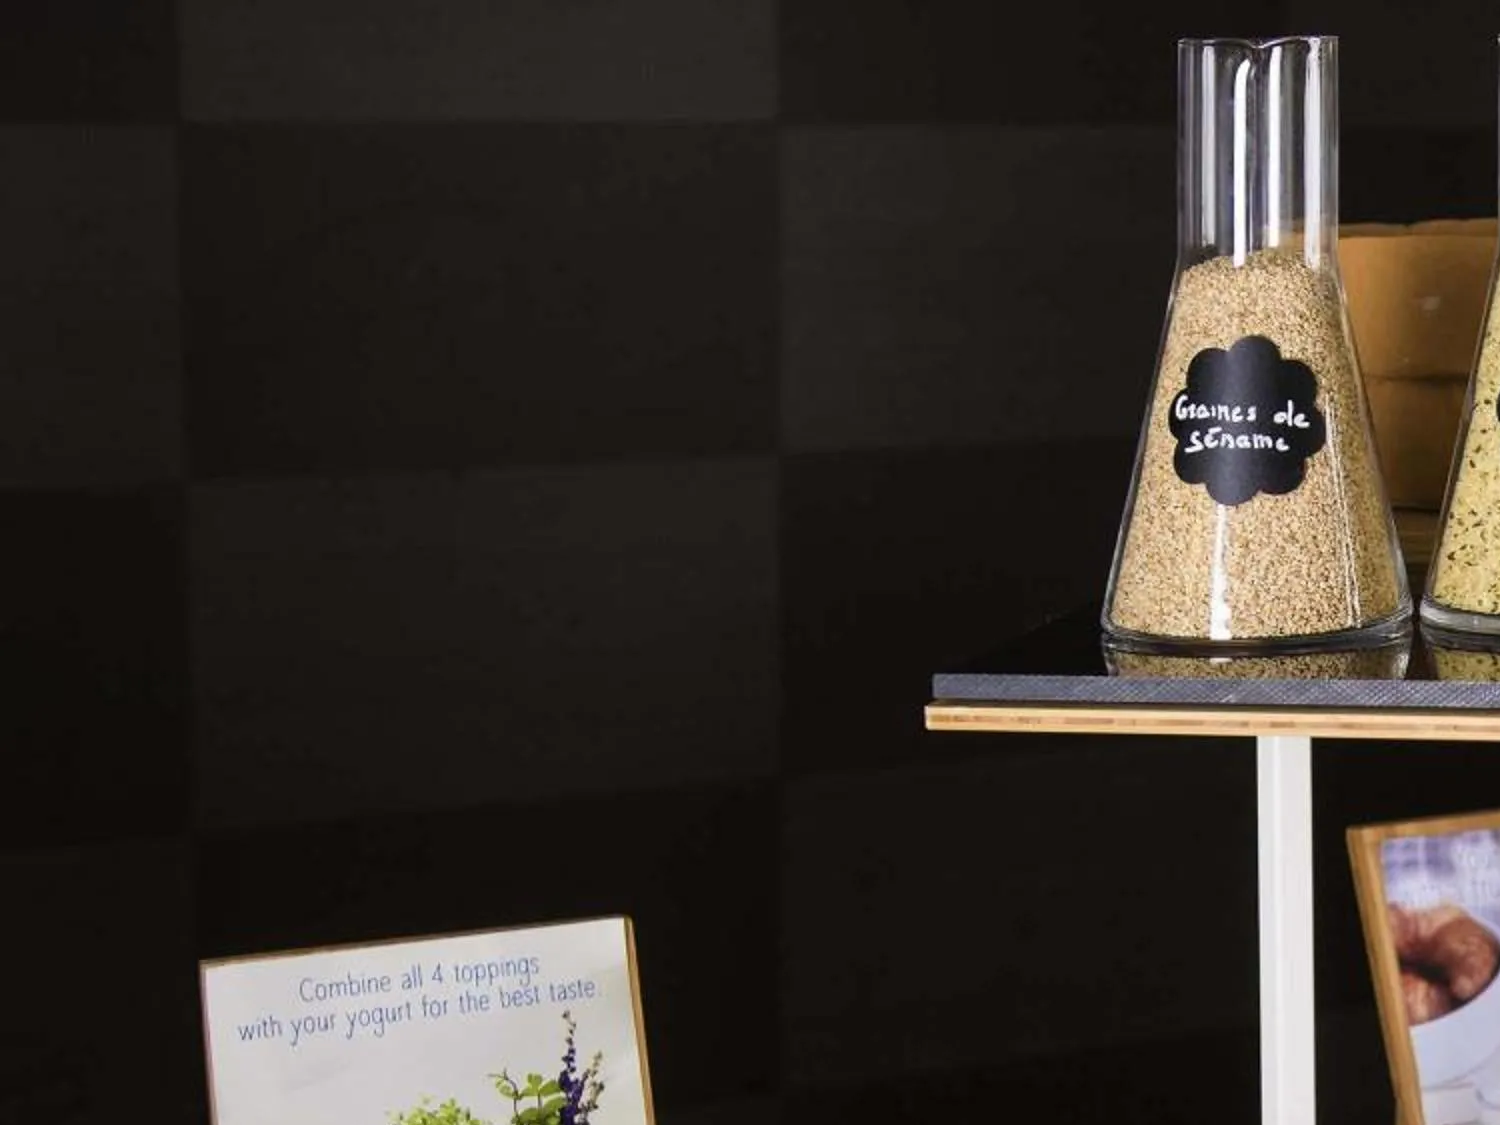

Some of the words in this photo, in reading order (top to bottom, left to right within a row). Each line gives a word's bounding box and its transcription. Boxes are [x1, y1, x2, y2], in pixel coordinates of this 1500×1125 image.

[1174, 394, 1258, 423] Graines
[1273, 399, 1311, 428] de
[299, 972, 392, 1003] Combine
[401, 964, 424, 991] all
[431, 962, 445, 986] 4
[455, 954, 541, 989] toppings
[238, 1015, 283, 1042] with
[290, 1016, 337, 1046] your
[345, 1001, 414, 1040] yogurt
[421, 994, 450, 1019] for
[459, 988, 490, 1015] the
[501, 983, 541, 1010] best
[549, 978, 597, 1003] taste
